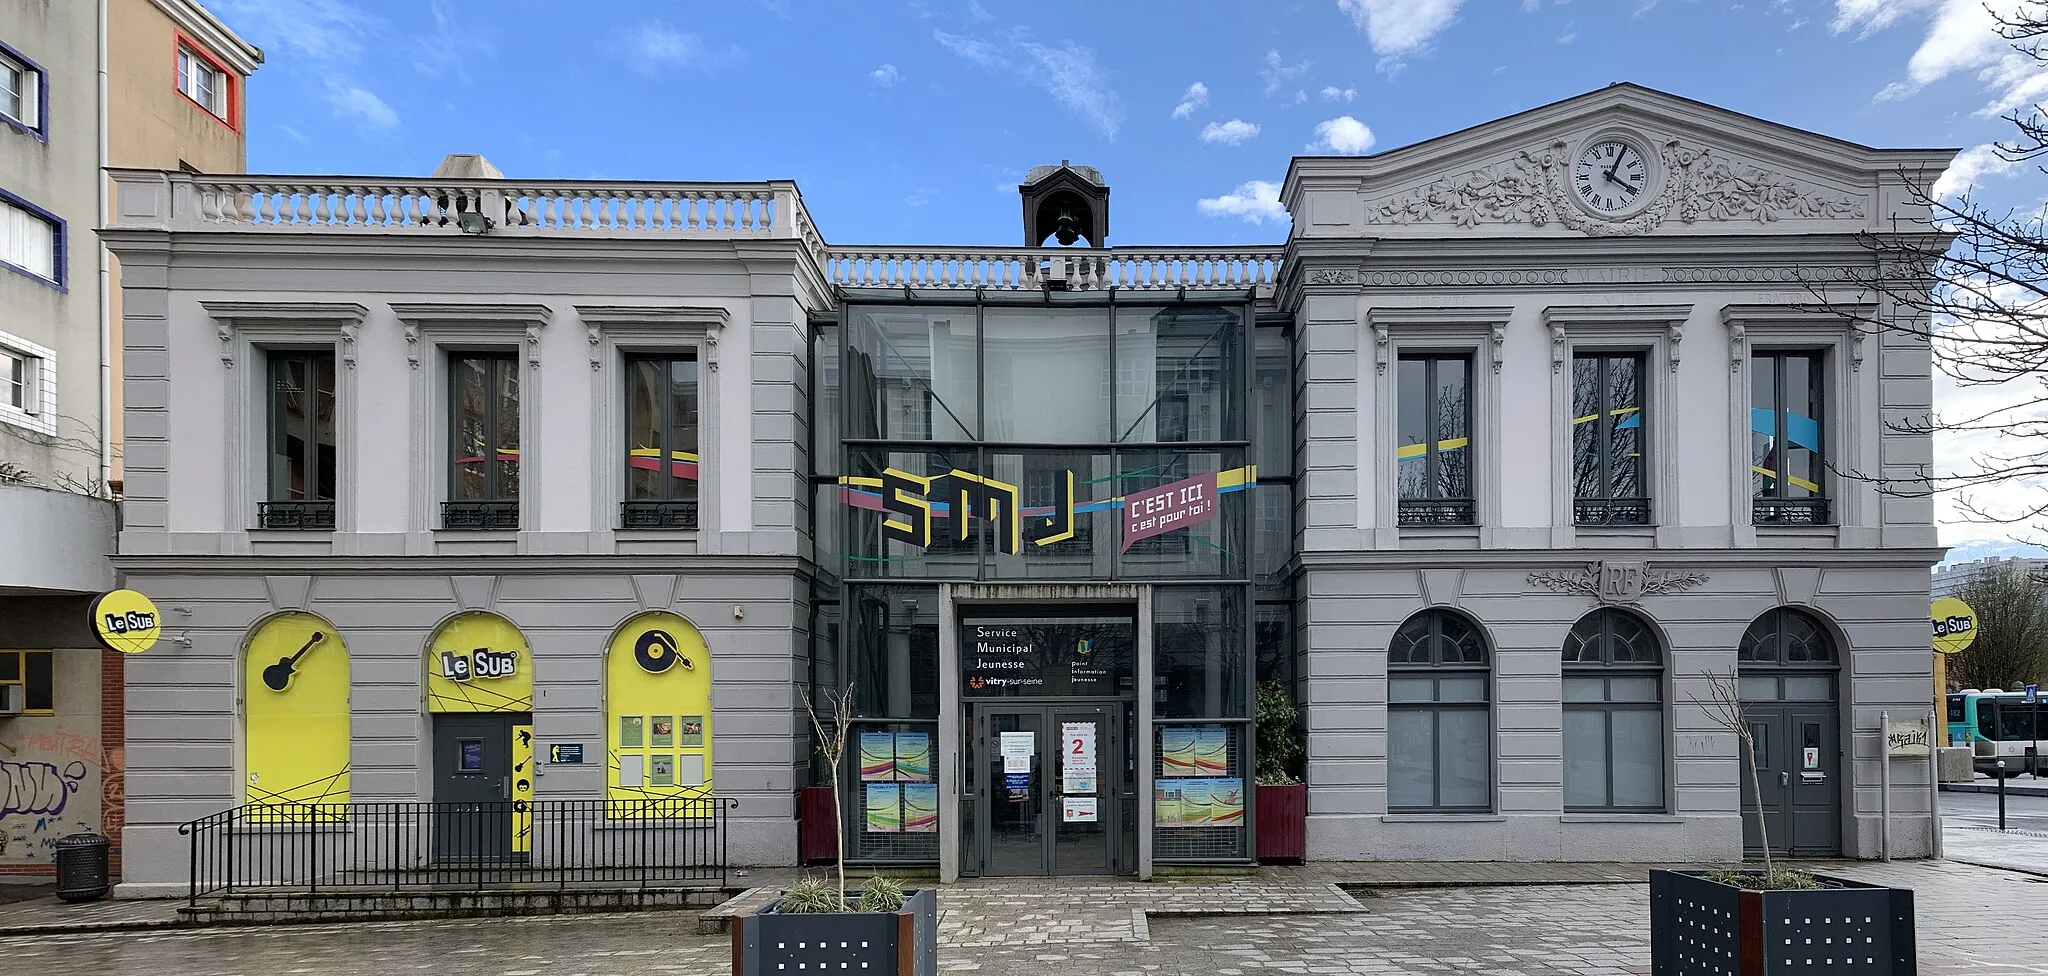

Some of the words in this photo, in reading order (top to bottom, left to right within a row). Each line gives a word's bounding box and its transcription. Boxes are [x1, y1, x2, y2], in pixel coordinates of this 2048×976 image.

[1576, 267, 1651, 283] MAIRIE
[1131, 491, 1174, 518] C'EST
[1180, 483, 1203, 505] ICI
[1159, 509, 1186, 529] pour
[1188, 501, 1204, 517] toi
[1606, 566, 1638, 597] RF
[106, 616, 125, 631] Le
[976, 626, 1017, 638] Service
[976, 641, 1032, 655] Municipal
[442, 655, 468, 677] Le
[976, 657, 1025, 669] Jeunesse
[1071, 667, 1107, 675] information
[985, 676, 1043, 687] vitry-sur-seine
[1072, 738, 1084, 755] 2
